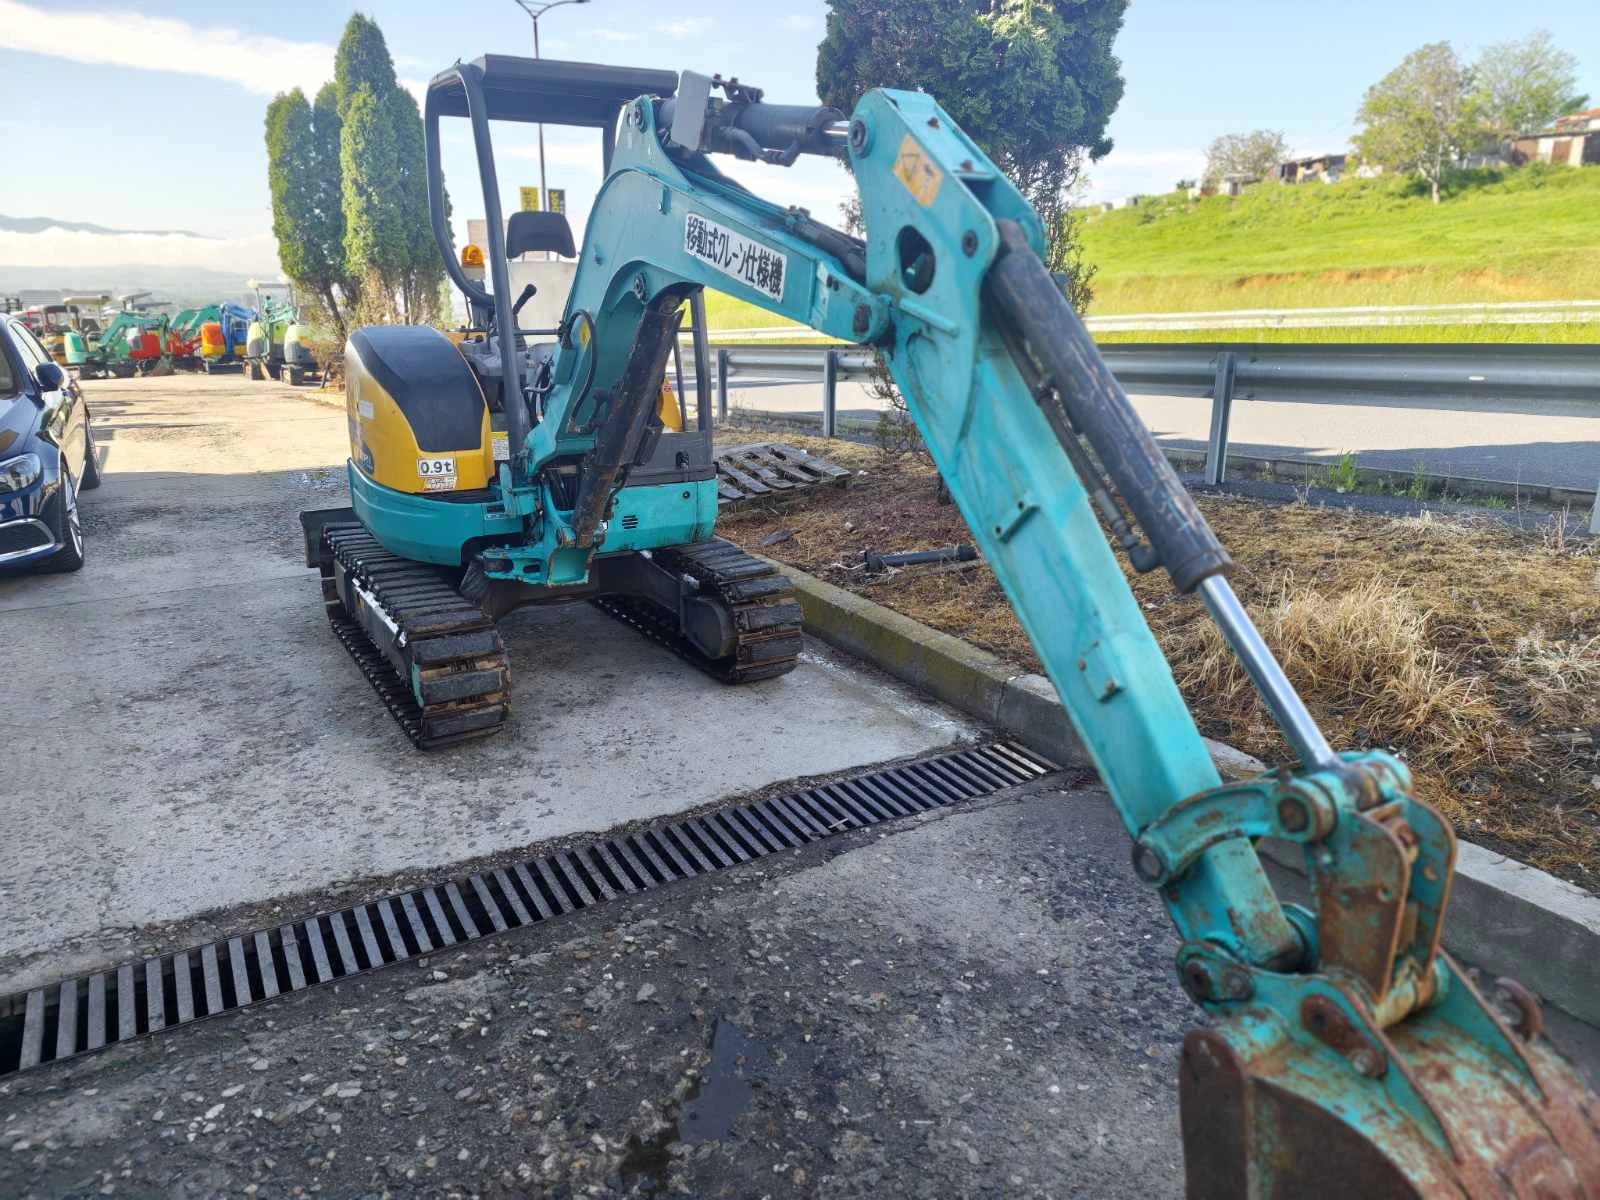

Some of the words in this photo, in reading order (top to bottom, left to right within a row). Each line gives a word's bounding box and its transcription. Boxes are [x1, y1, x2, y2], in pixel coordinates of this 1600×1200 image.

[686, 215, 783, 297] 移動式クレーン仕様機
